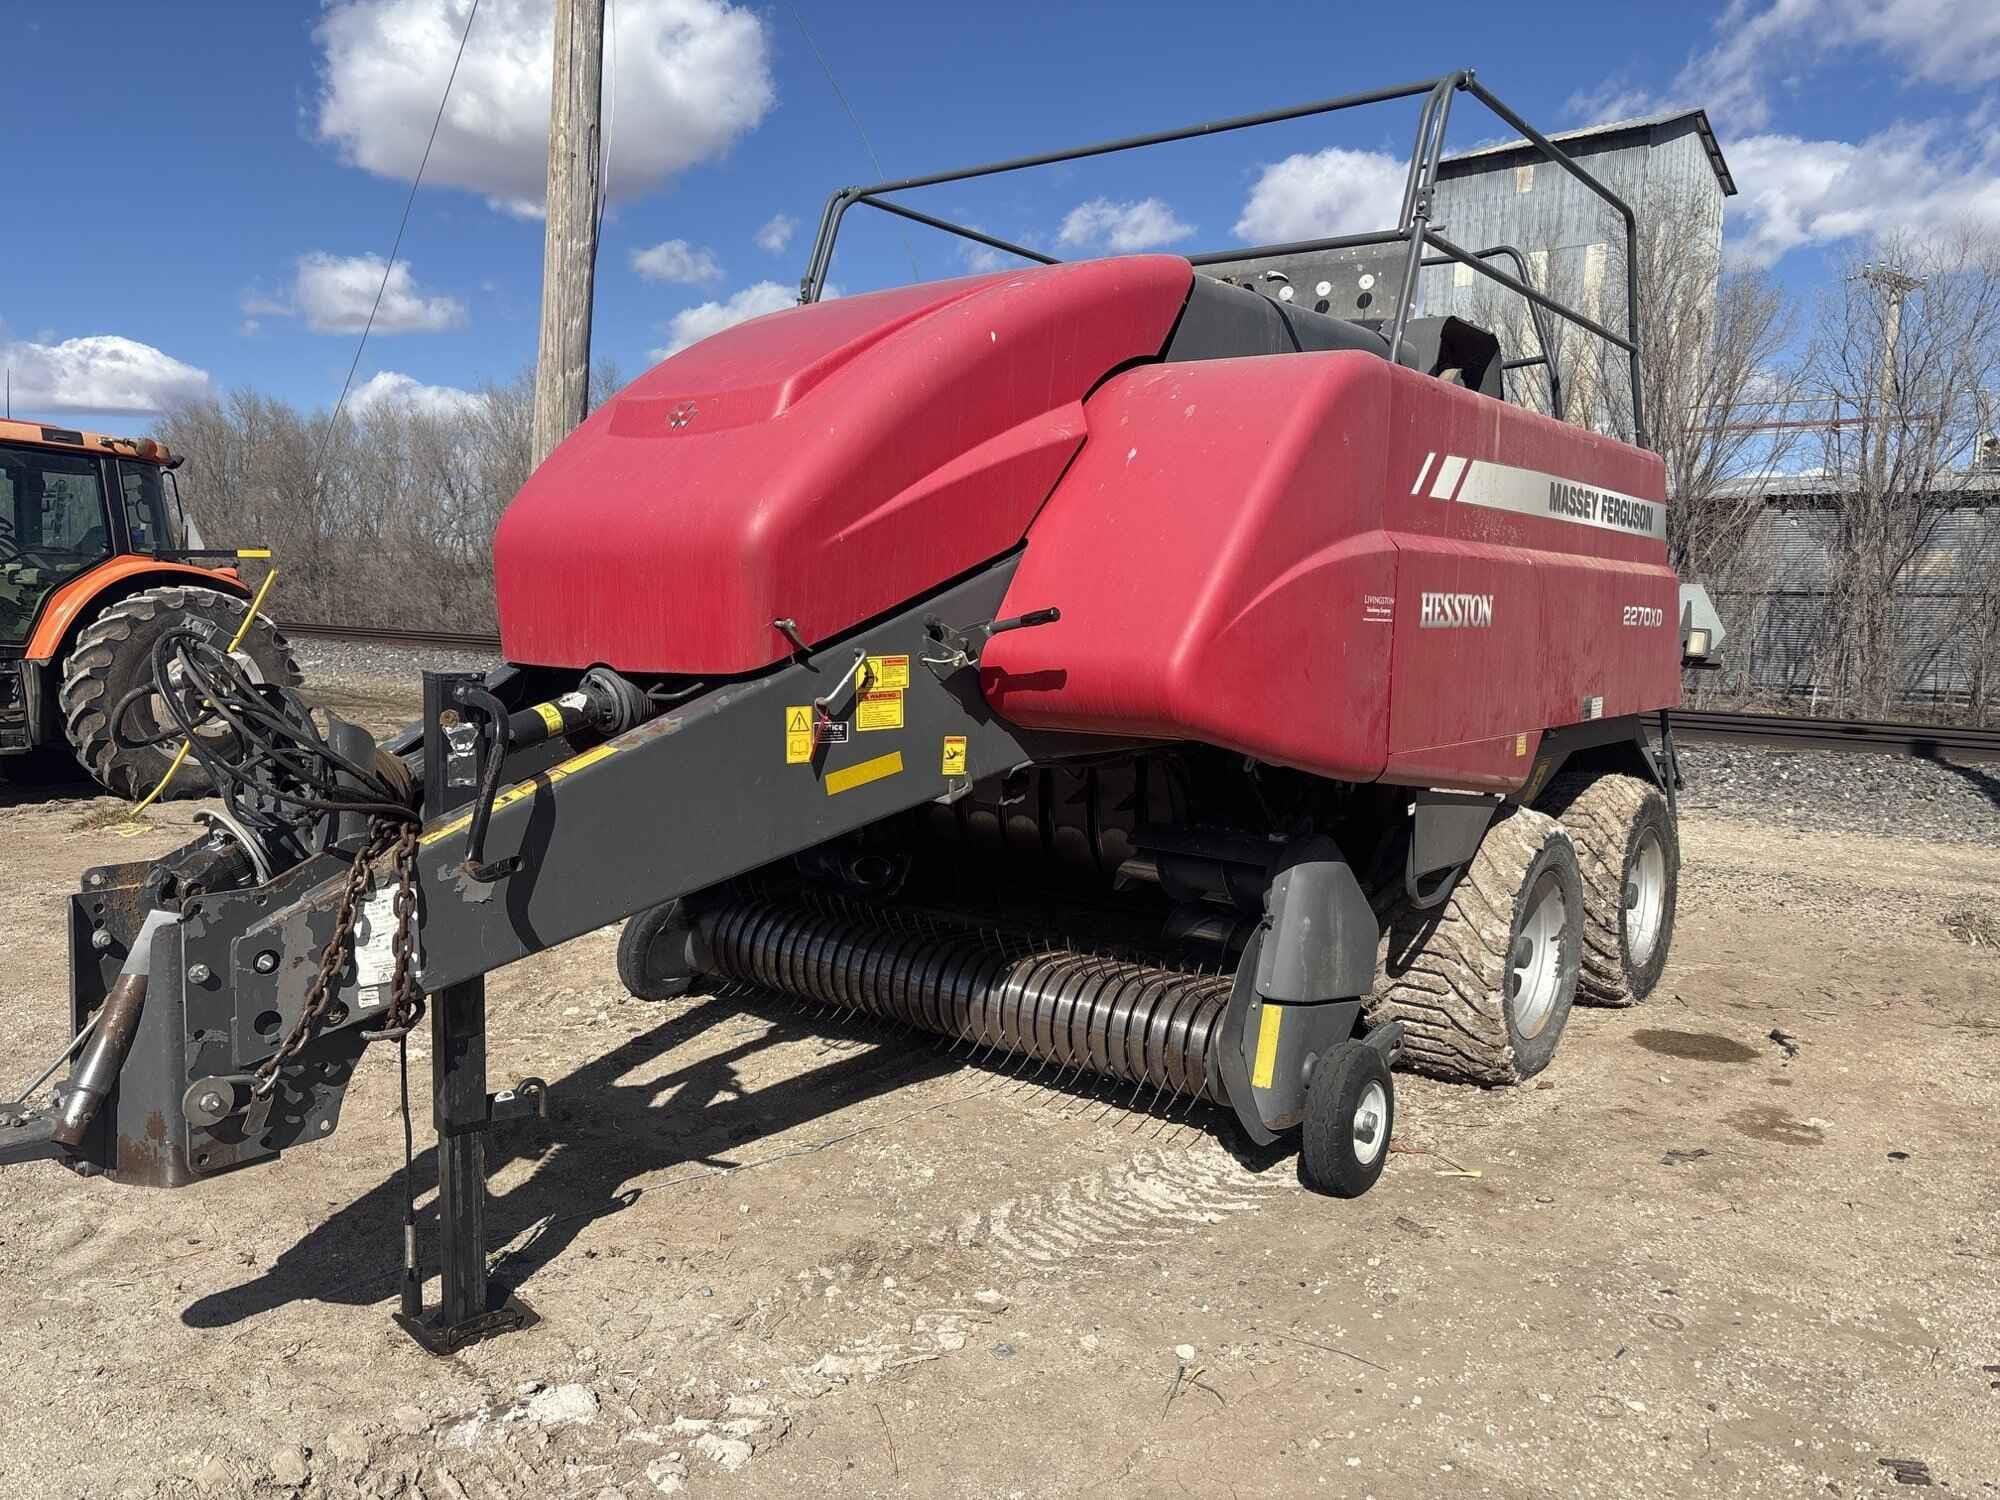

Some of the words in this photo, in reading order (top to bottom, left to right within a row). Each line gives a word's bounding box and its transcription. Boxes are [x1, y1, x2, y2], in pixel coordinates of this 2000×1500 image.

[1549, 481, 1599, 520] MASSEY
[1601, 494, 1654, 532] FERGUSON
[1420, 592, 1494, 629] HESSTON
[1623, 606, 1663, 627] 2270XD
